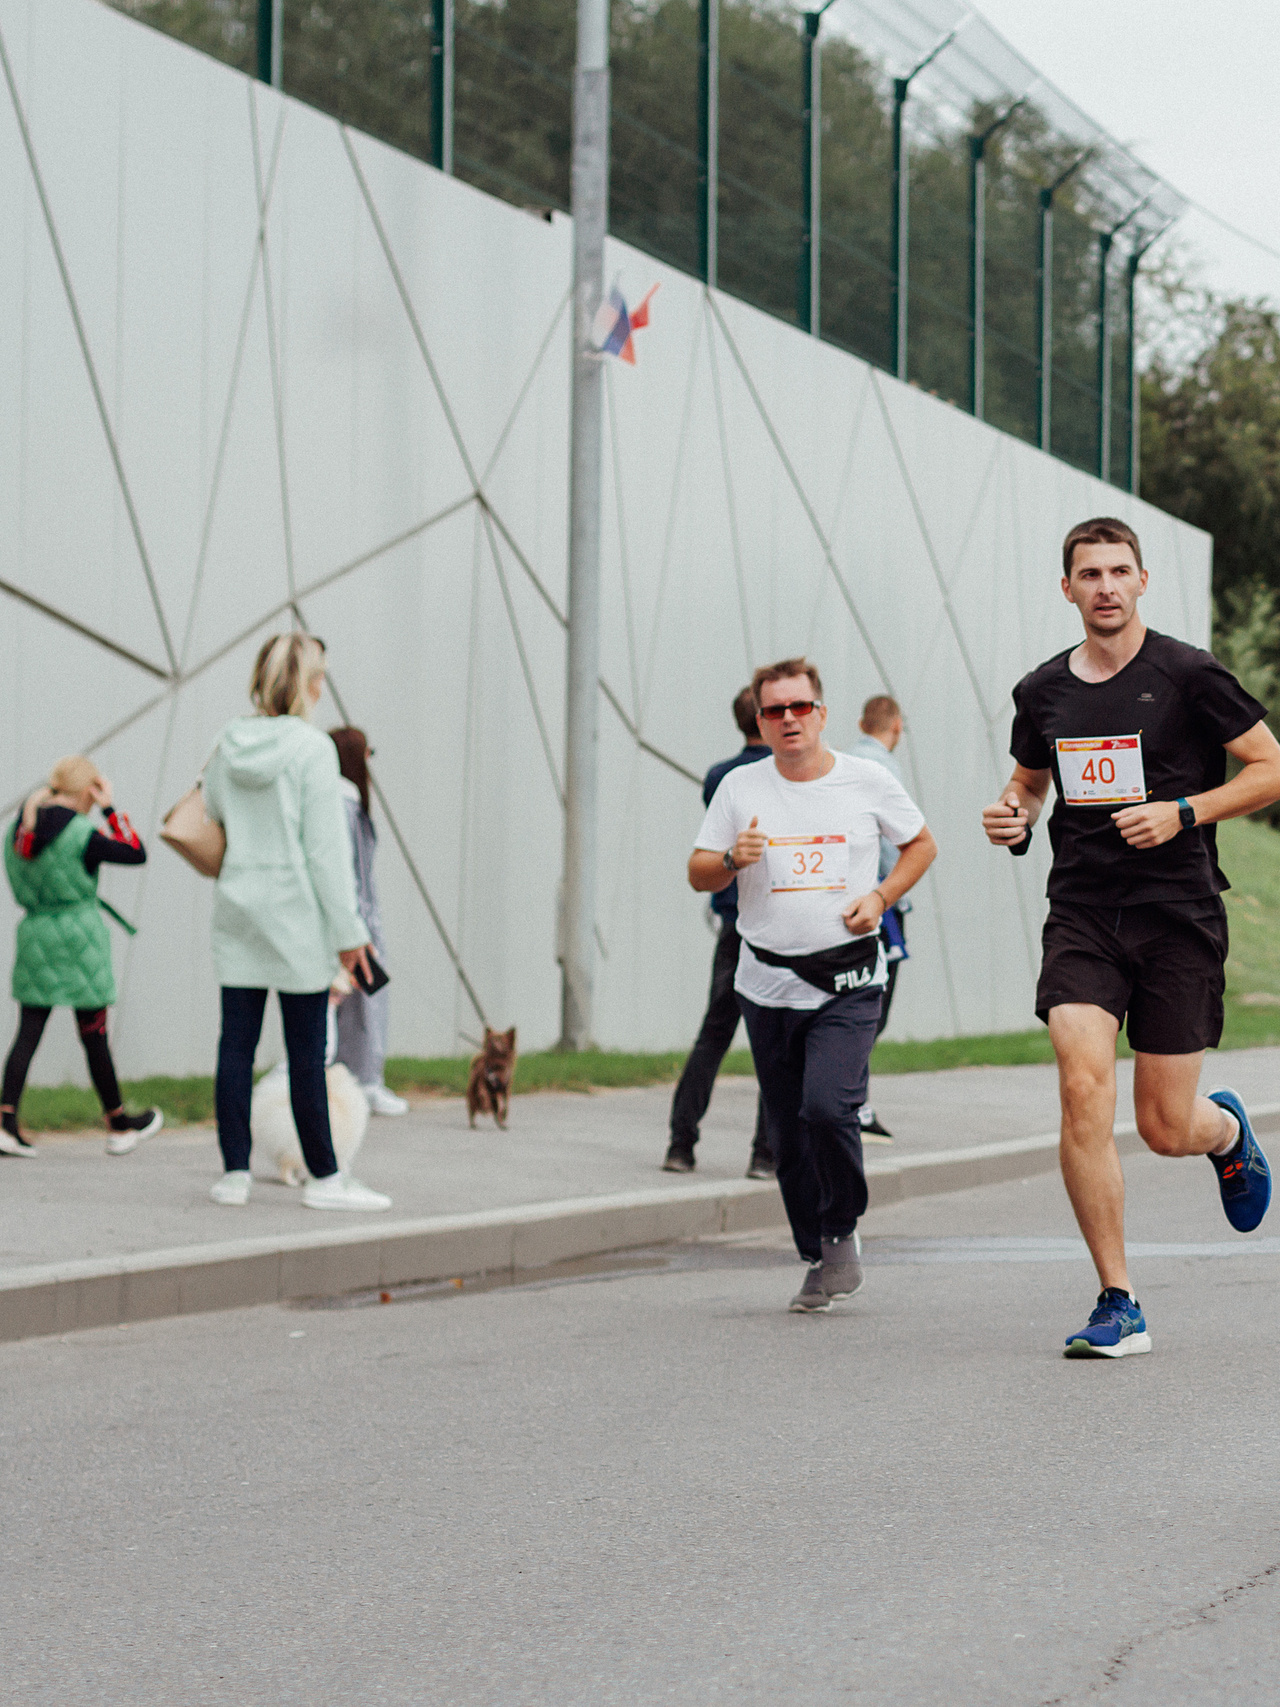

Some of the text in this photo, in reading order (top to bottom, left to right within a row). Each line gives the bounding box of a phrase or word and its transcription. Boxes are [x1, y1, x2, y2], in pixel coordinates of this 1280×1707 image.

[1081, 757, 1116, 785] 40
[792, 851, 824, 875] 32
[834, 966, 872, 992] FILA
